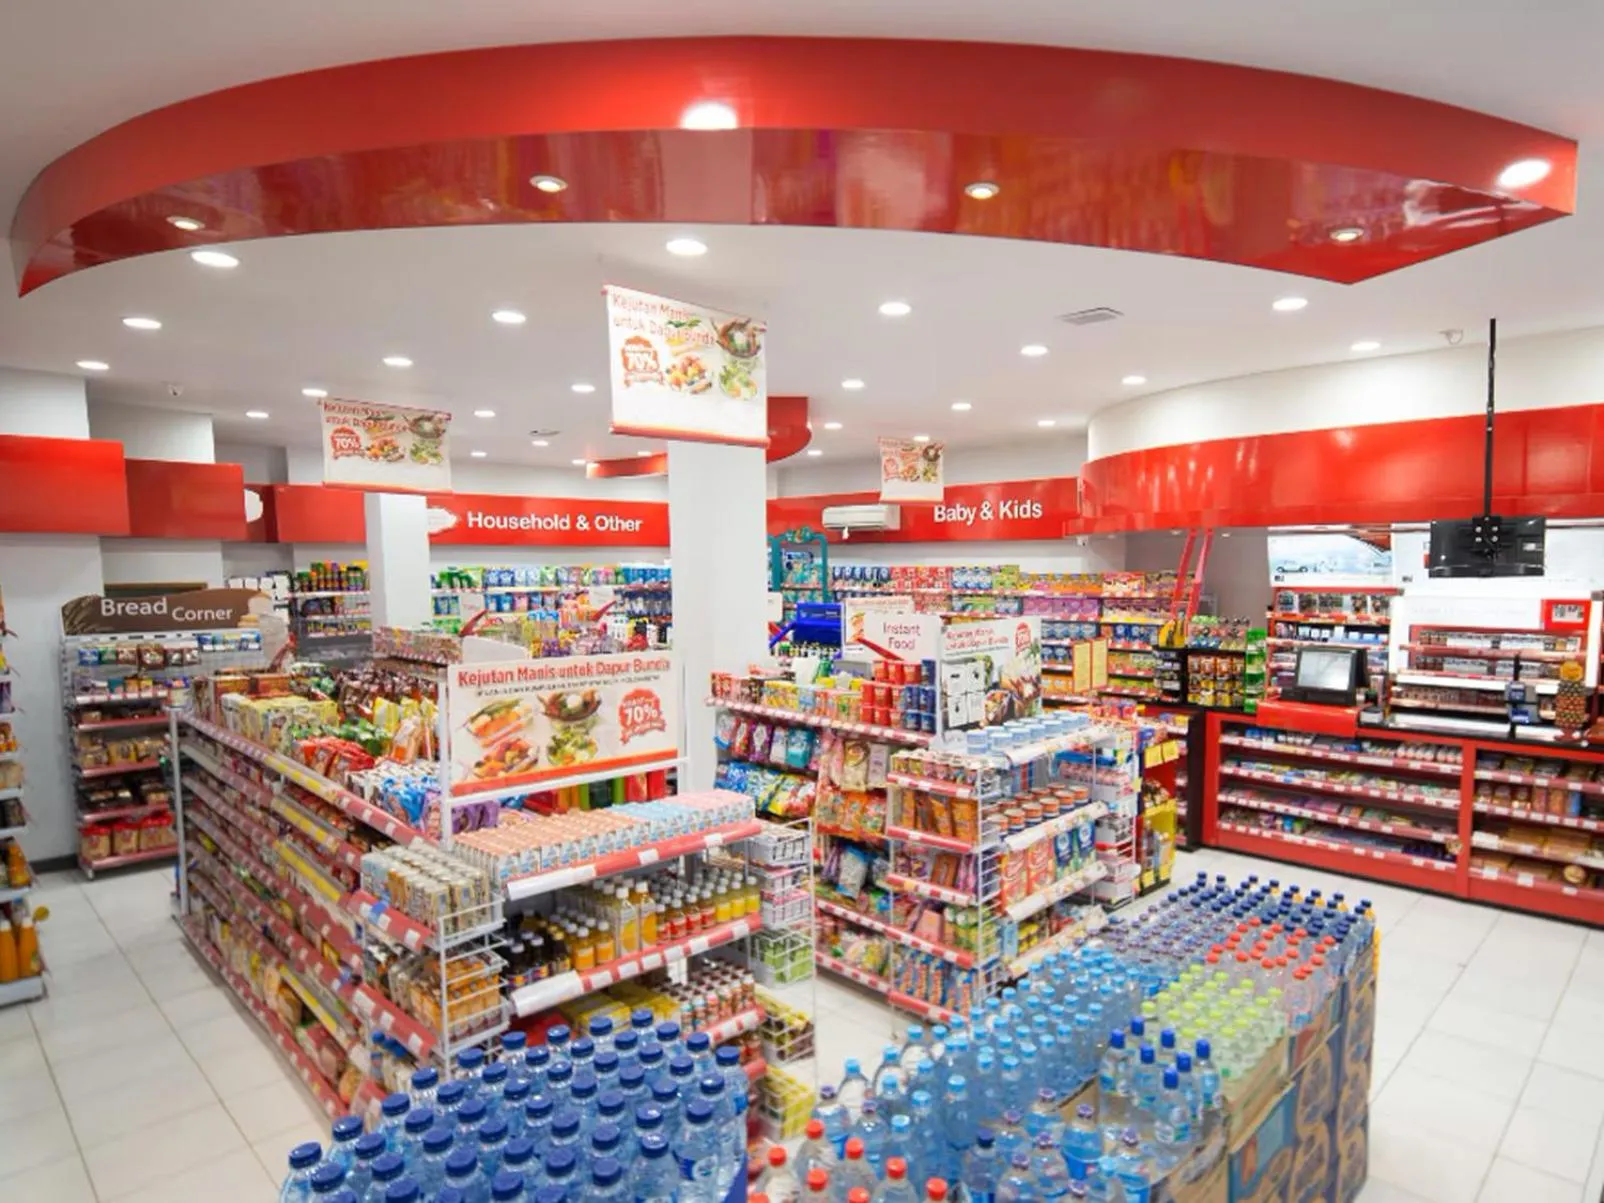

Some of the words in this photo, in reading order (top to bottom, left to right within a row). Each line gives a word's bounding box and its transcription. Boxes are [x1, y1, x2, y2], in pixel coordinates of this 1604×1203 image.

[467, 512, 571, 531] Household
[576, 514, 590, 531] &
[594, 515, 643, 532] Other
[933, 503, 977, 526] Baby
[980, 501, 994, 521] &
[999, 500, 1043, 519] Kids
[101, 597, 168, 617] Bread
[171, 606, 233, 622] Corner
[883, 622, 921, 636] Instant
[888, 638, 916, 650] Food
[457, 668, 515, 688] Kejutan
[516, 664, 556, 681] Manis
[558, 662, 594, 678] untuk
[595, 660, 632, 678] Dapur
[624, 705, 659, 726] 70%
